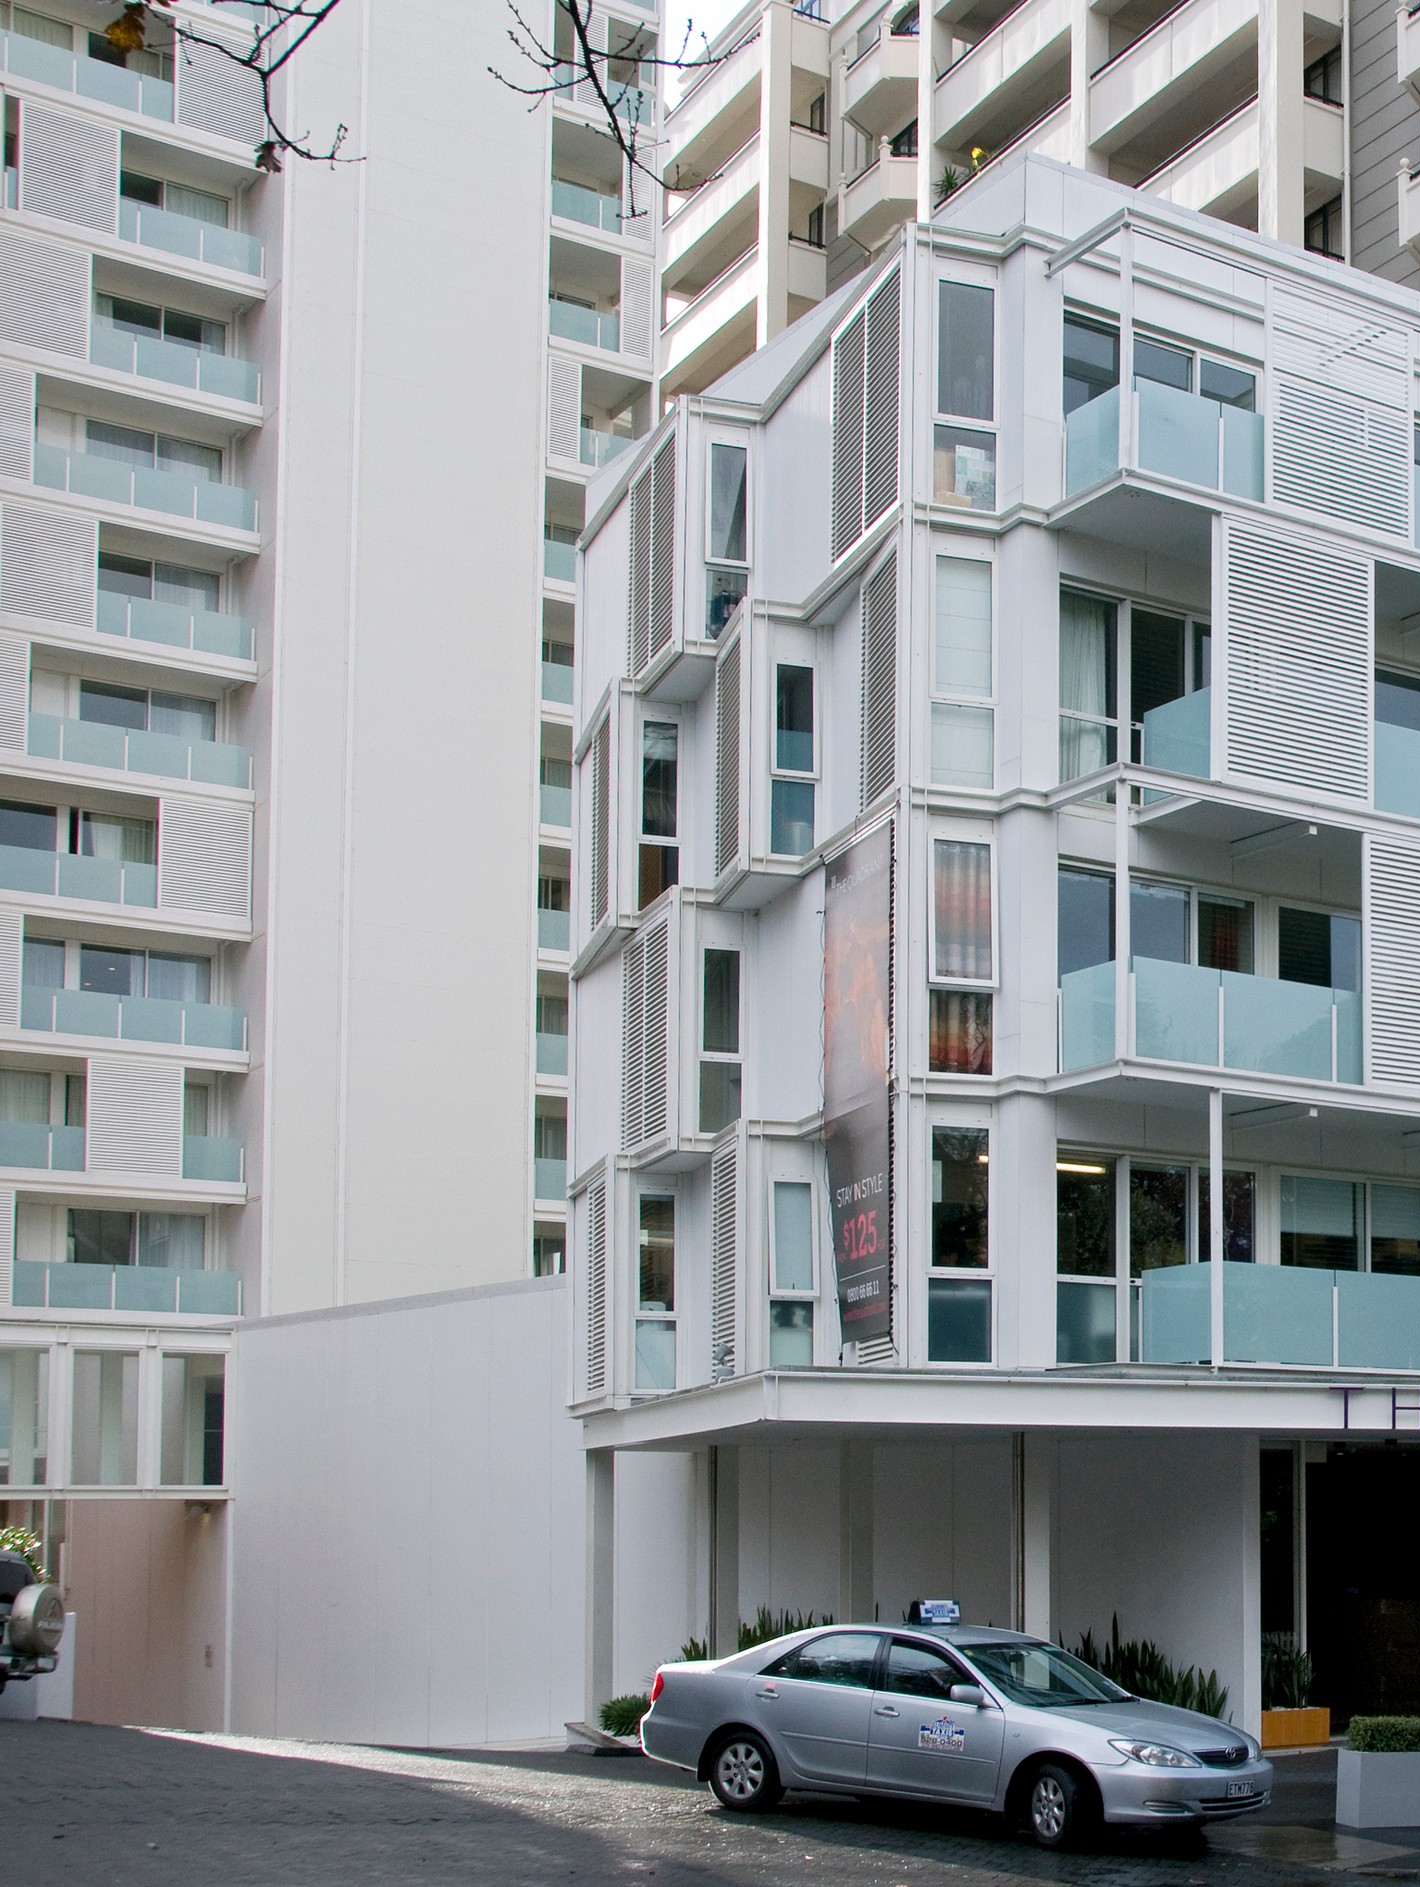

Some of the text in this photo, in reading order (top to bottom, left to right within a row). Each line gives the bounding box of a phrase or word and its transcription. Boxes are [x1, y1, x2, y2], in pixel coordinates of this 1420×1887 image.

[836, 1185, 853, 1208] STAY
[861, 1173, 883, 1198] STYLE
[843, 1210, 877, 1260] $125
